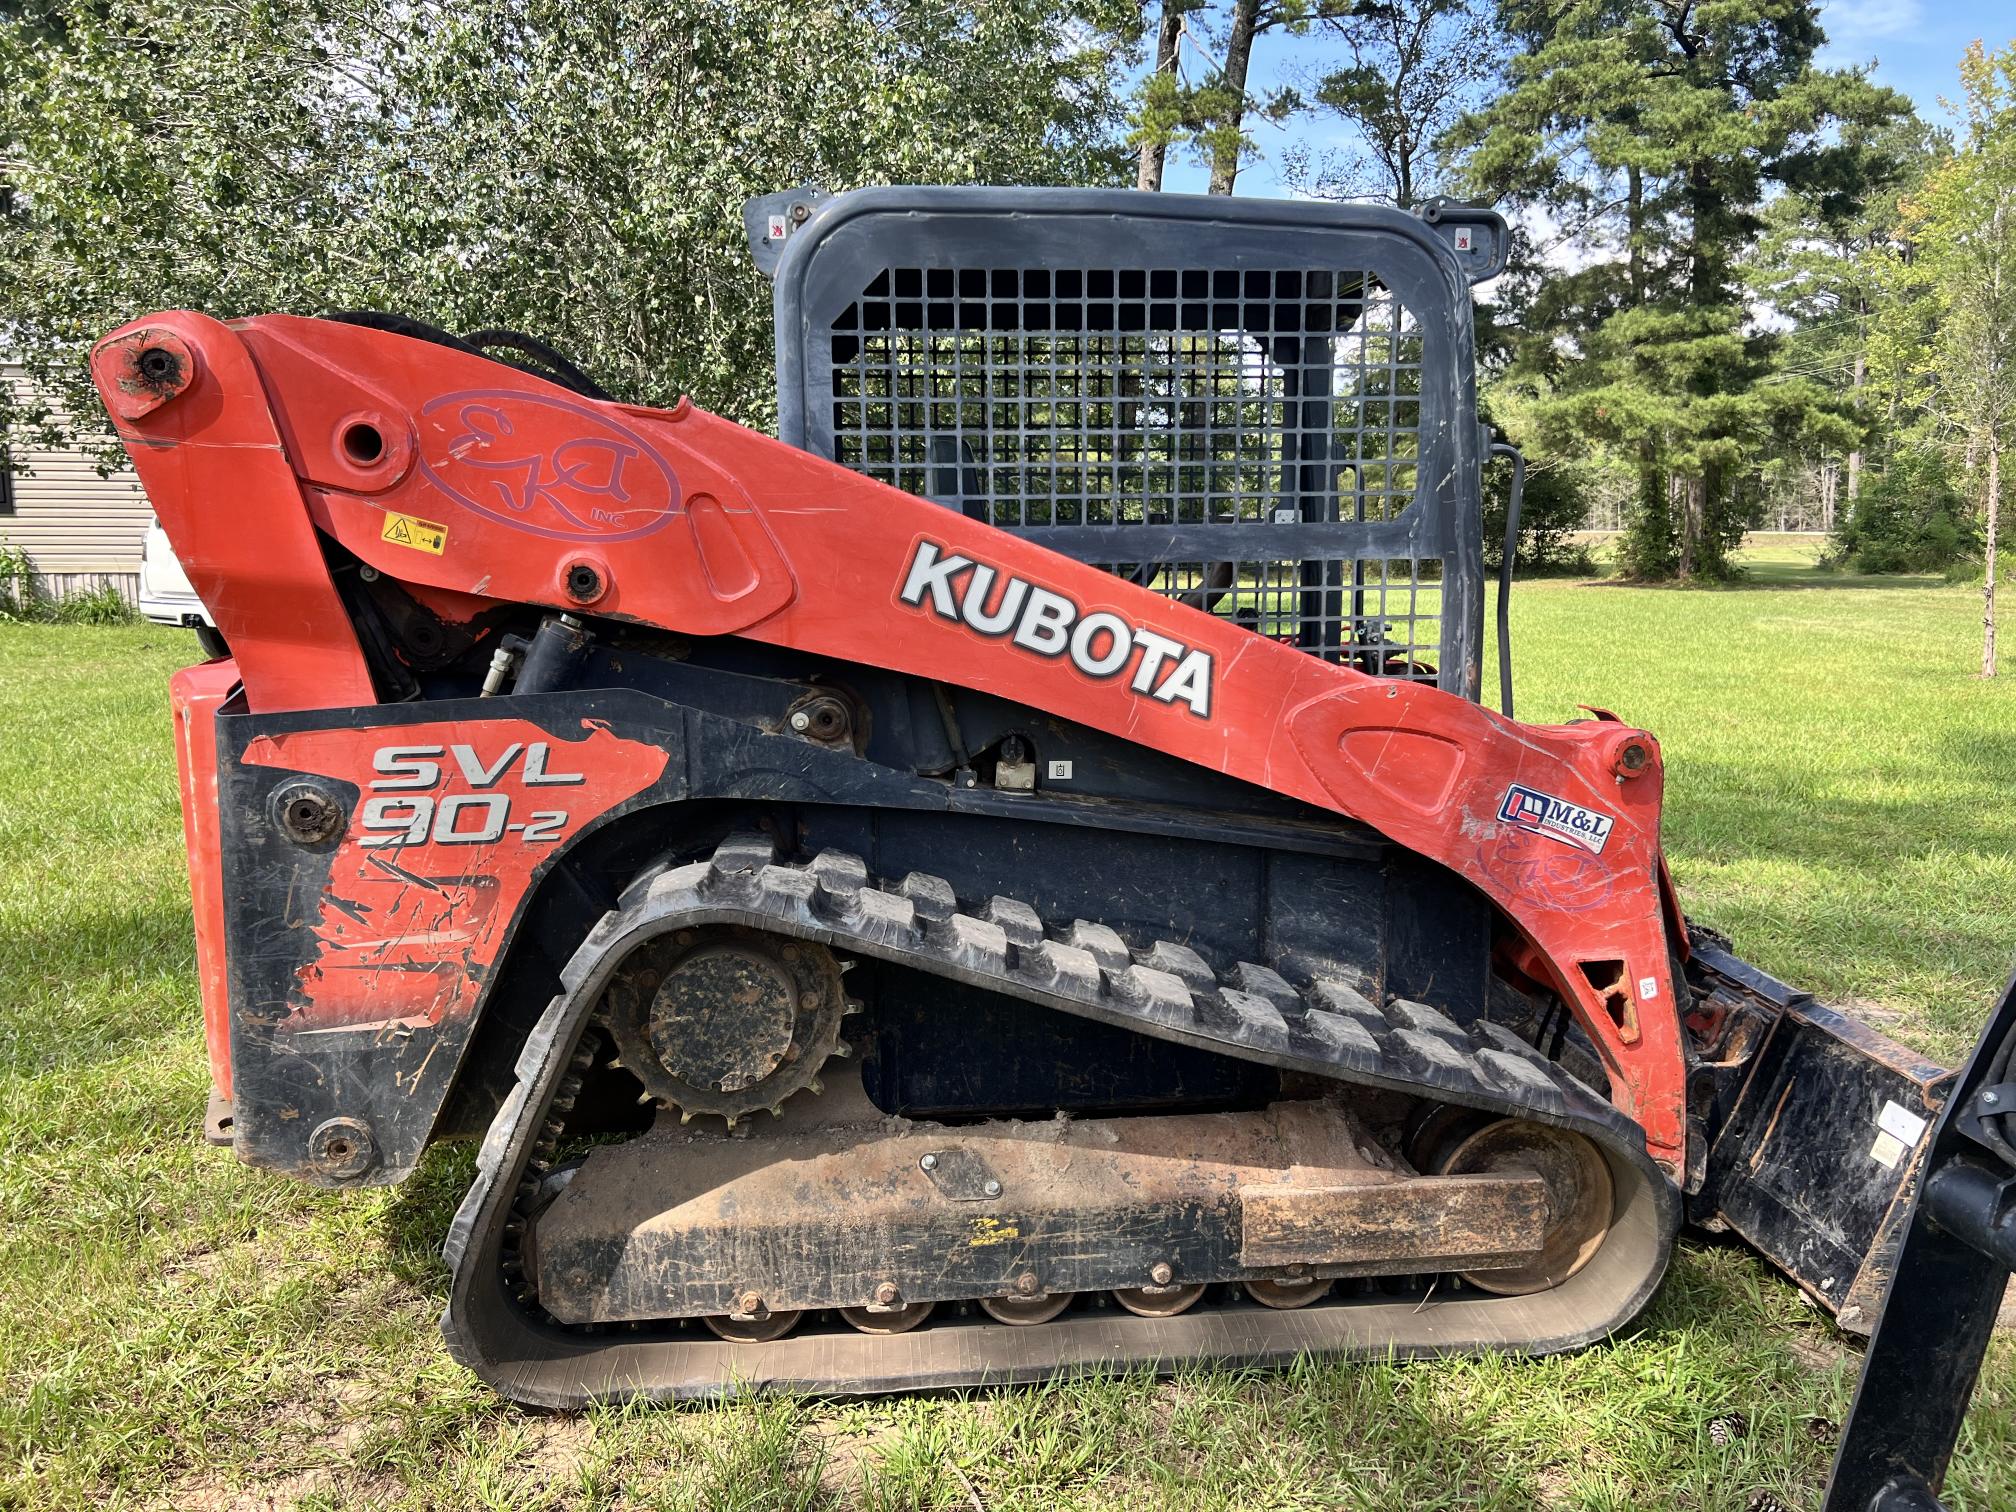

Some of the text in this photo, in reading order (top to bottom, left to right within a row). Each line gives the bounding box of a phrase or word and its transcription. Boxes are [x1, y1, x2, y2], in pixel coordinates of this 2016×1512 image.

[901, 541, 1211, 718] KUBOTA
[368, 742, 586, 792] SVL
[356, 793, 568, 848] 90-2
[1548, 801, 1607, 837] M&L
[1588, 835, 1603, 845] LLC
